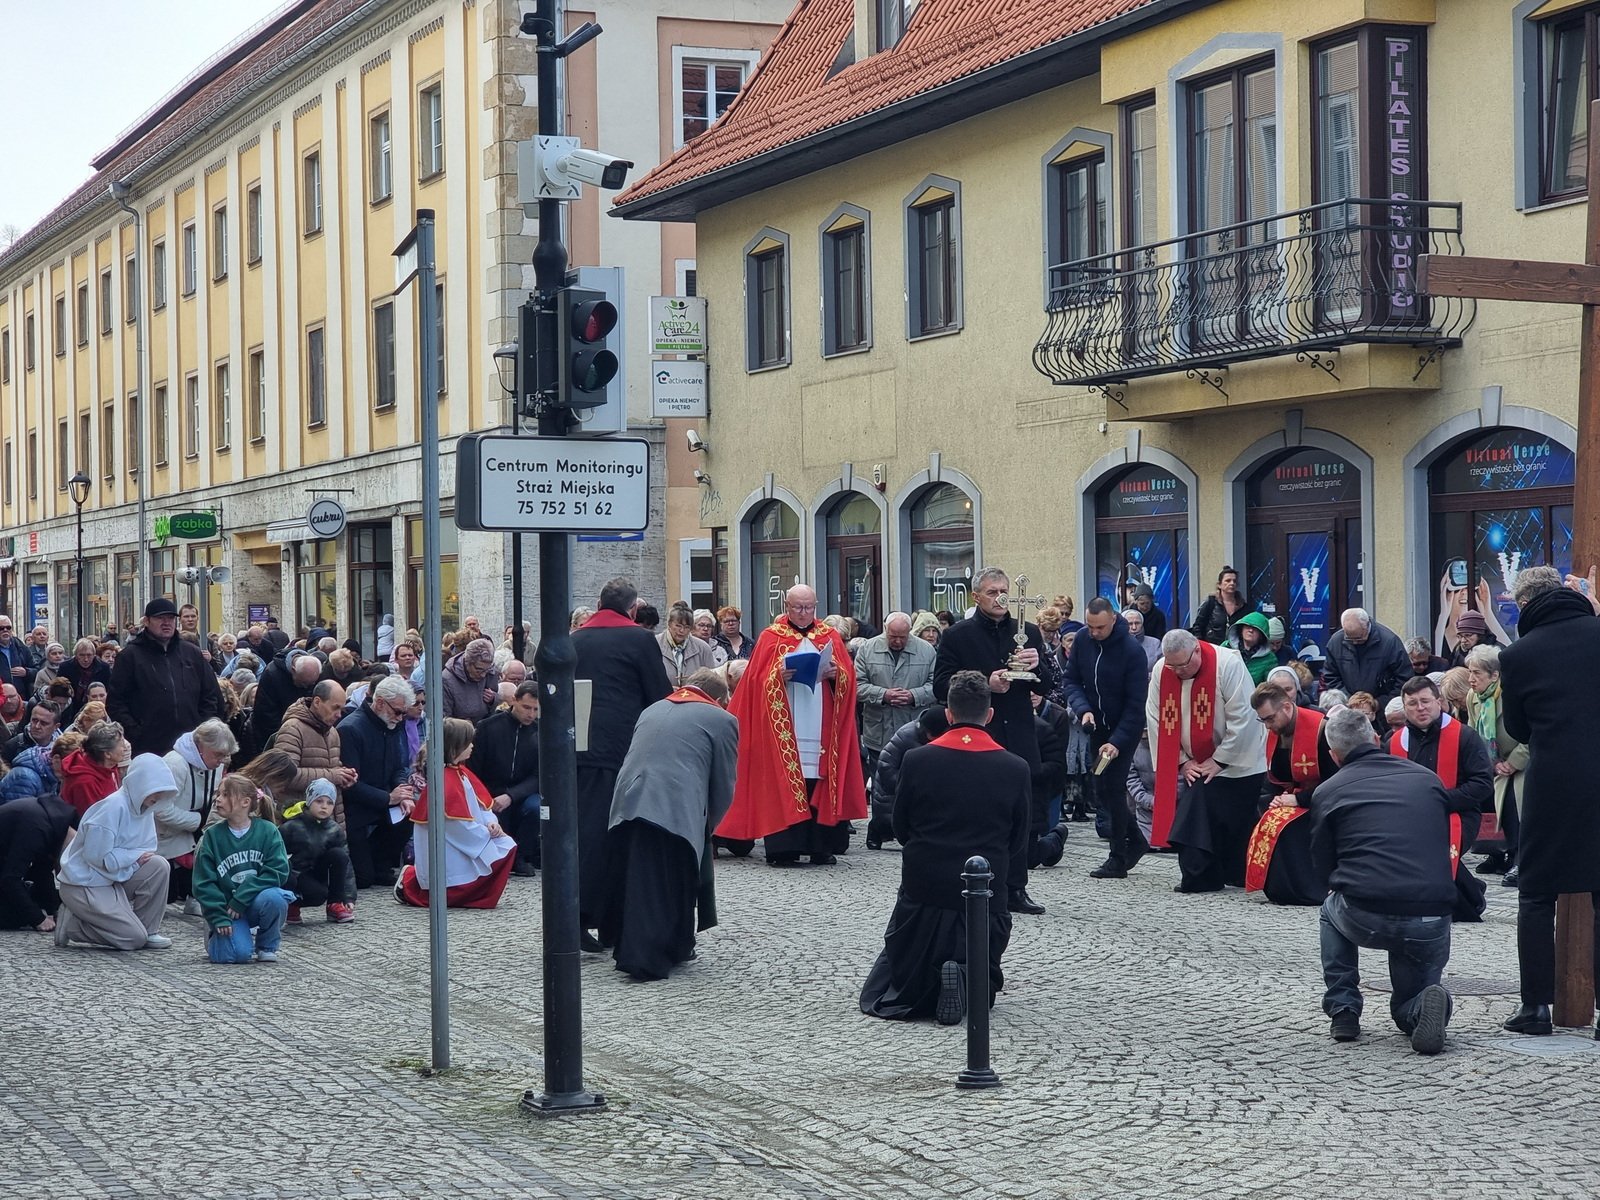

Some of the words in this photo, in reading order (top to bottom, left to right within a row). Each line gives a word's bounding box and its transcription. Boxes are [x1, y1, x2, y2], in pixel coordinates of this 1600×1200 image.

[1388, 42, 1412, 176] PILATES
[658, 320, 684, 330] Active
[685, 322, 700, 334] 24
[664, 328, 684, 337] Care
[1466, 444, 1550, 463] VirtualVerse
[486, 458, 548, 472] Centrum
[556, 460, 643, 477] Monitoringu
[1276, 463, 1344, 479] VirtualVerse
[1470, 464, 1512, 476] rzeczywistość
[1513, 463, 1525, 472] bez
[1525, 462, 1546, 473] granic
[516, 480, 552, 494] Straż
[561, 481, 614, 497] Miejska
[1120, 479, 1176, 493] VirtualVerse
[518, 501, 533, 514] 75
[541, 501, 565, 515] 752
[574, 502, 586, 515] 51
[595, 502, 612, 515] 62
[176, 519, 212, 528] żabka
[312, 512, 342, 524] cukru
[1300, 568, 1320, 602] V
[217, 850, 248, 878] BEVERLY
